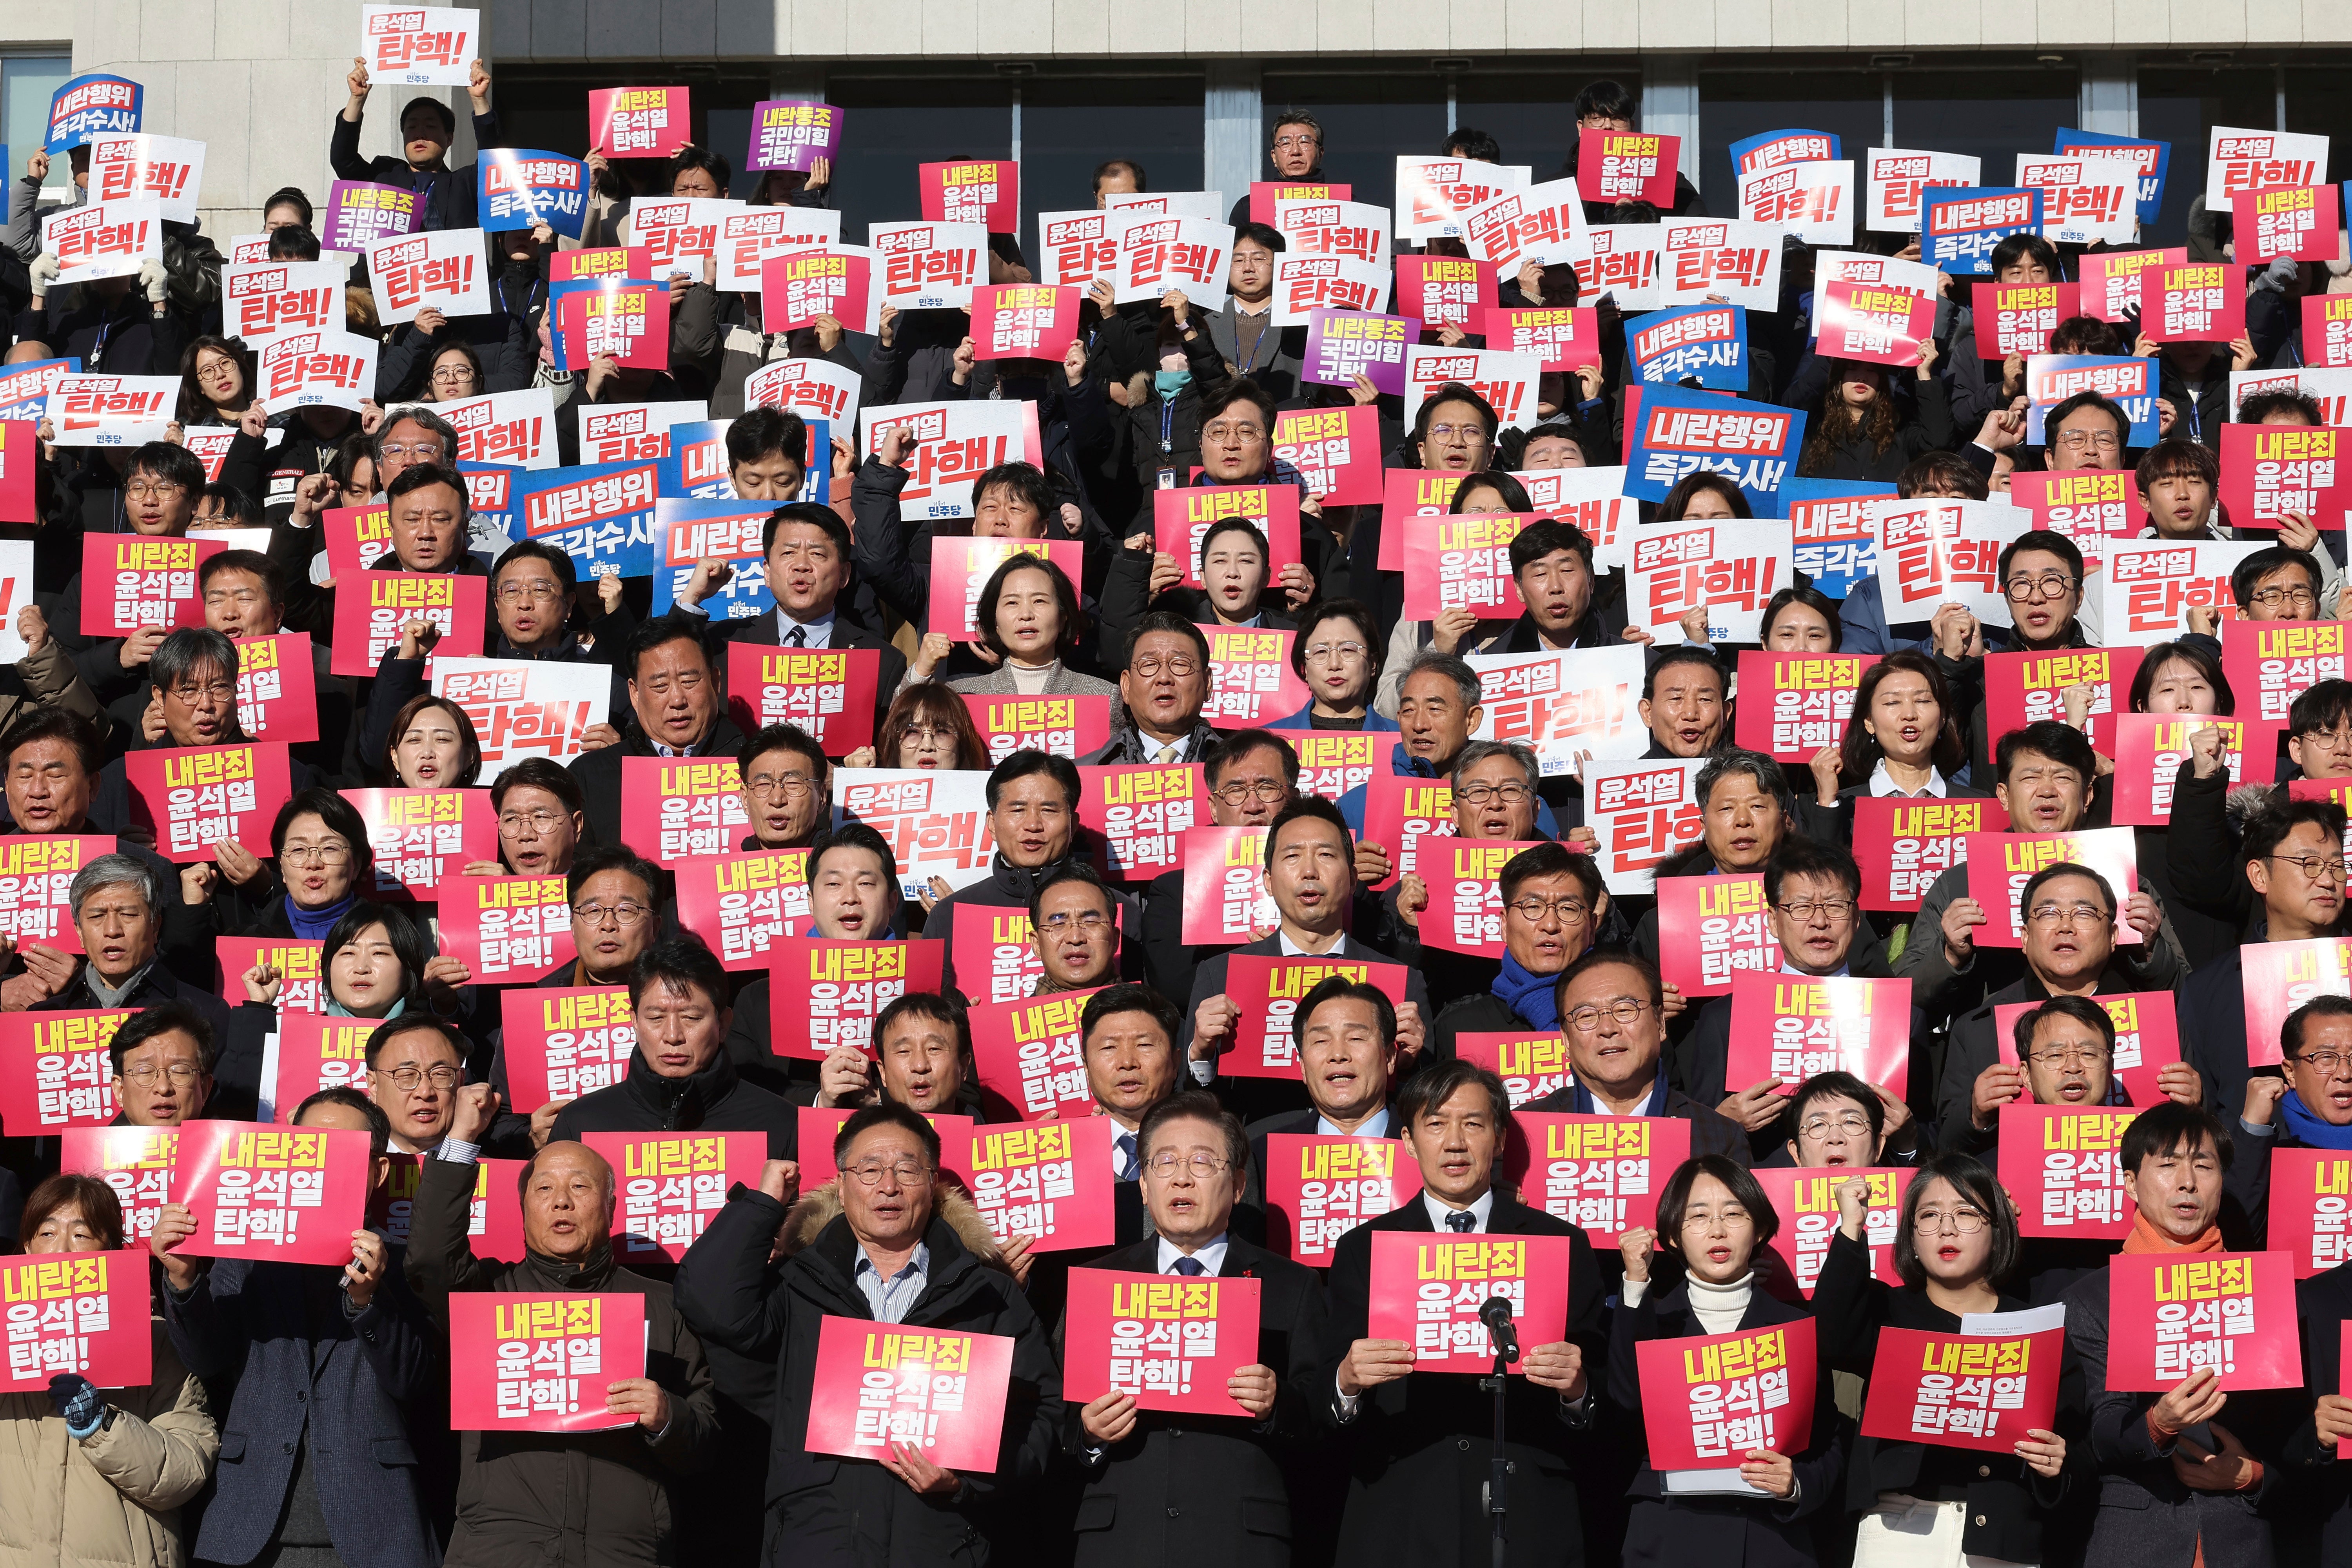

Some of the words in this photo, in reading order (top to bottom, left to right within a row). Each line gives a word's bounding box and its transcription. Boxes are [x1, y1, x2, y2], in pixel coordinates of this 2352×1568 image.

[372, 13, 422, 33] 윤석열
[377, 32, 467, 71] 탄핵!
[54, 84, 131, 120] 내란행위
[614, 89, 667, 111] 내란죄
[612, 109, 668, 132] 윤석열
[763, 107, 831, 127] 내란동조
[613, 129, 657, 151] 탄핵!
[760, 126, 829, 147] 국민의힘
[1604, 137, 1659, 156] 내란죄
[2220, 139, 2271, 158] 윤석열
[757, 145, 798, 167] 규탄!
[1602, 157, 1657, 176] 윤석열
[1877, 158, 1928, 178] 윤석열
[943, 163, 997, 186] 내란죄
[1601, 177, 1644, 196] 탄핵!
[1748, 171, 1794, 198] 윤석열
[2026, 165, 2079, 185] 윤석열
[341, 189, 414, 213] 내란동조
[944, 183, 997, 207] 윤석열
[2257, 188, 2314, 214] 내란죄
[50, 210, 101, 237] 윤석열
[335, 207, 411, 234] 국민의힘
[639, 205, 687, 227] 윤석열
[728, 214, 781, 236] 윤석열
[1287, 207, 1338, 229] 윤석열
[1470, 198, 1520, 238] 윤석열
[1935, 196, 2028, 230] 내란행위
[2258, 209, 2315, 236] 윤석열
[877, 229, 931, 252] 윤석열
[1050, 218, 1102, 244] 윤석열
[1125, 222, 1178, 247] 윤석열
[1484, 203, 1570, 269] 탄핵!
[1670, 227, 1724, 249] 윤석열
[2060, 230, 2085, 240] 민주당
[2258, 232, 2303, 257] 탄핵!
[376, 240, 425, 270] 윤석열
[572, 250, 628, 274] 내란죄
[787, 257, 846, 280] 내란죄
[1131, 241, 1220, 288] 탄핵!
[1283, 260, 1337, 278] 윤석열
[1676, 249, 1770, 290] 탄핵!
[232, 270, 284, 295] 윤석열
[387, 254, 473, 310] 탄핵!
[886, 249, 975, 296] 탄핵!
[1423, 262, 1477, 282] 내란죄
[2165, 267, 2224, 290] 내란죄
[787, 277, 846, 300] 윤석열
[918, 297, 943, 307] 민주당
[996, 288, 1056, 309] 내란죄
[1423, 282, 1478, 303] 윤석열
[1851, 291, 1913, 314] 내란죄
[1997, 286, 2057, 310] 내란죄
[2165, 288, 2223, 313] 윤석열
[241, 287, 332, 336] 탄핵!
[586, 293, 646, 317] 내란죄
[788, 296, 833, 323] 탄핵!
[993, 308, 1055, 331] 윤석열
[1512, 310, 1573, 327] 내란죄
[586, 314, 645, 338] 윤석열
[1324, 318, 1405, 340] 내란동조
[1513, 325, 1573, 345] 윤석열
[1639, 311, 1730, 359] 내란행위
[1997, 308, 2057, 333] 윤석열
[2165, 311, 2211, 335] 탄핵!
[266, 335, 317, 365] 윤석열
[993, 329, 1040, 352] 탄핵!
[1321, 339, 1403, 364] 국민의힘
[1844, 330, 1893, 354] 탄핵!
[270, 354, 365, 401] 탄핵!
[1416, 358, 1475, 379] 윤석열
[1643, 343, 1739, 384] 즉각수사!
[59, 381, 119, 392] 윤석열
[753, 365, 803, 397] 윤석열
[298, 395, 323, 404] 민주당
[590, 412, 644, 434] 윤석열
[1652, 413, 1784, 450] 내란행위
[96, 435, 122, 444] 민주당
[2256, 430, 2336, 460] 내란죄
[2047, 474, 2125, 506] 내란죄
[2255, 460, 2335, 490] 윤석열
[532, 470, 653, 529] 내란행위
[928, 506, 961, 517] 민주당
[1189, 489, 1268, 522] 내란죄
[1440, 517, 1521, 550] 내란죄
[2048, 503, 2127, 535] 윤석열
[117, 543, 196, 570] 내란죄
[1638, 531, 1710, 568] 윤석열
[2117, 551, 2192, 575] 윤석열
[115, 572, 194, 599] 윤석열
[590, 564, 621, 577] 민주당
[371, 579, 454, 607] 내란죄
[114, 600, 176, 630] 탄핵!
[728, 606, 761, 618] 민주당
[2259, 625, 2344, 658] 내란죄
[762, 653, 846, 684] 내란죄
[1481, 662, 1557, 701] 윤석열
[1775, 659, 1860, 689] 내란죄
[446, 672, 523, 701] 윤석열
[761, 684, 844, 715] 윤석열
[989, 699, 1074, 732] 내란죄
[165, 748, 254, 787] 내란죄
[168, 780, 256, 820] 윤석열
[848, 783, 929, 815] 윤석열
[1105, 768, 1193, 804] 내란죄
[1600, 771, 1680, 804] 윤석열
[1105, 800, 1194, 838] 윤석열
[1893, 803, 1981, 837] 내란죄
[1107, 835, 1176, 869] 탄핵!
[480, 936, 553, 973] 탄핵!
[811, 945, 907, 981] 내란죄
[38, 1087, 113, 1124] 탄핵!
[220, 1132, 327, 1168] 내란죄
[972, 1123, 1071, 1171] 내란죄
[1547, 1122, 1650, 1159] 내란죄
[626, 1137, 725, 1176] 내란죄
[1301, 1144, 1395, 1179] 내란죄
[217, 1170, 324, 1207] 윤석열
[974, 1160, 1074, 1209] 윤석열
[1546, 1159, 1649, 1197] 윤석열
[625, 1174, 726, 1215] 윤석열
[1300, 1180, 1392, 1218] 윤석열
[2043, 1189, 2123, 1225] 탄핵!
[214, 1209, 298, 1245] 탄핵!
[1418, 1241, 1526, 1280] 내란죄
[4, 1256, 108, 1302] 내란죄
[2155, 1258, 2252, 1301] 내란죄
[1113, 1283, 1218, 1319] 내란죄
[6, 1295, 109, 1342] 윤석열
[496, 1298, 601, 1339] 내란죄
[2156, 1297, 2255, 1342] 윤석열
[864, 1334, 971, 1373] 내란죄
[1111, 1321, 1216, 1357] 윤석열
[9, 1337, 89, 1380] 탄핵!
[496, 1337, 601, 1379] 윤석열
[1684, 1330, 1786, 1383] 내란죄
[1922, 1339, 2031, 1375] 내란죄
[860, 1371, 965, 1411] 윤석열
[1109, 1359, 1192, 1396] 탄핵!
[1917, 1374, 2027, 1408] 윤석열
[497, 1378, 579, 1418] 탄핵!
[1689, 1368, 1789, 1423] 윤석열
[854, 1410, 938, 1448] 탄핵!
[1692, 1411, 1775, 1457] 탄핵!
[1912, 1405, 1999, 1437] 탄핵!
